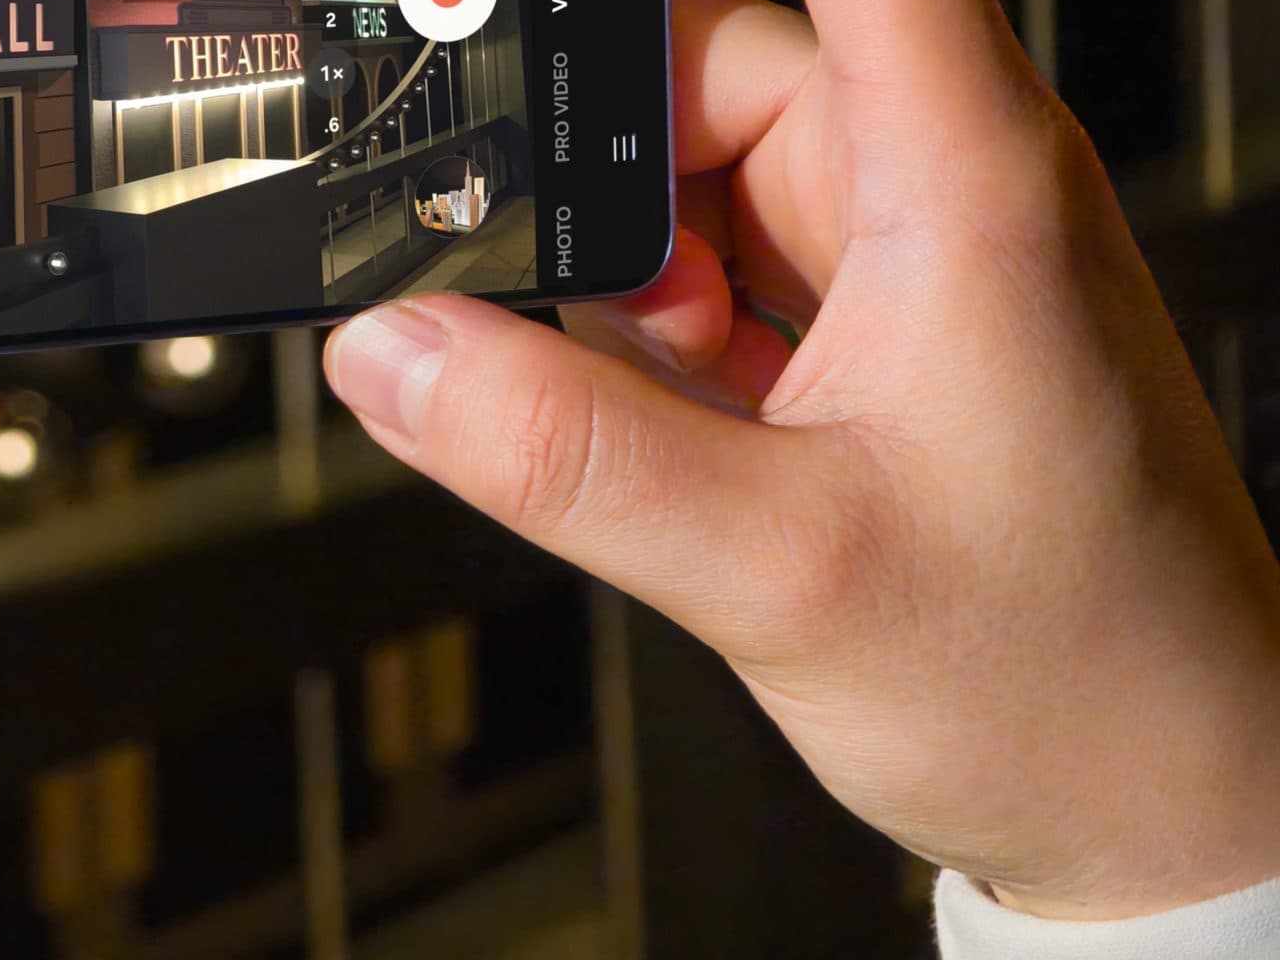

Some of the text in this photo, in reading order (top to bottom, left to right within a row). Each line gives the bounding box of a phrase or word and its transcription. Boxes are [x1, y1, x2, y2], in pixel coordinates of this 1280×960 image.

[325, 12, 336, 27] 2
[352, 7, 388, 38] NEWS
[165, 33, 303, 83] THEATER
[324, 117, 339, 134] .6
[553, 52, 570, 163] PRO VIDEO
[556, 206, 572, 278] PHOTO
